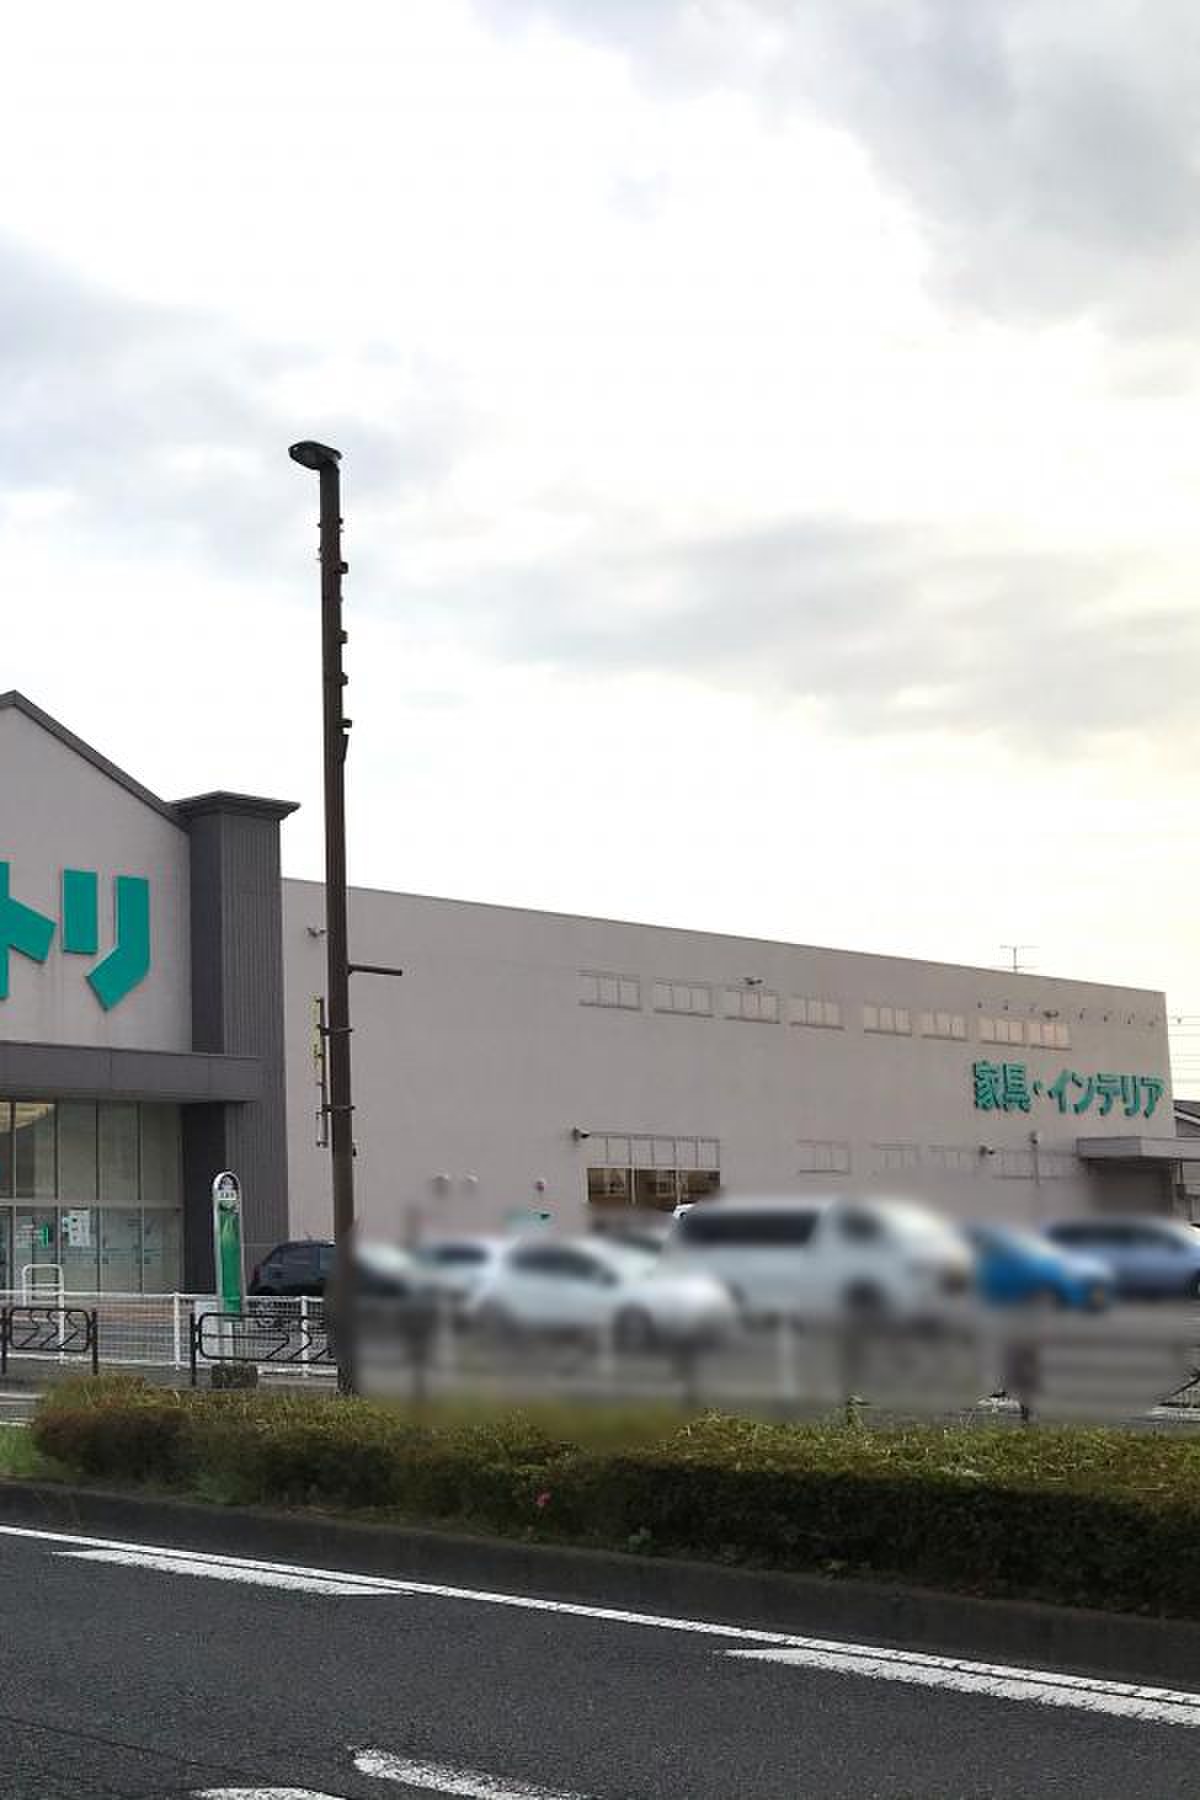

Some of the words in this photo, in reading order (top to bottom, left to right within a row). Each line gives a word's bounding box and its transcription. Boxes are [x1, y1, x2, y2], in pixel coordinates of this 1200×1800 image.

[973, 1060, 1167, 1119] 家具・インテリア
